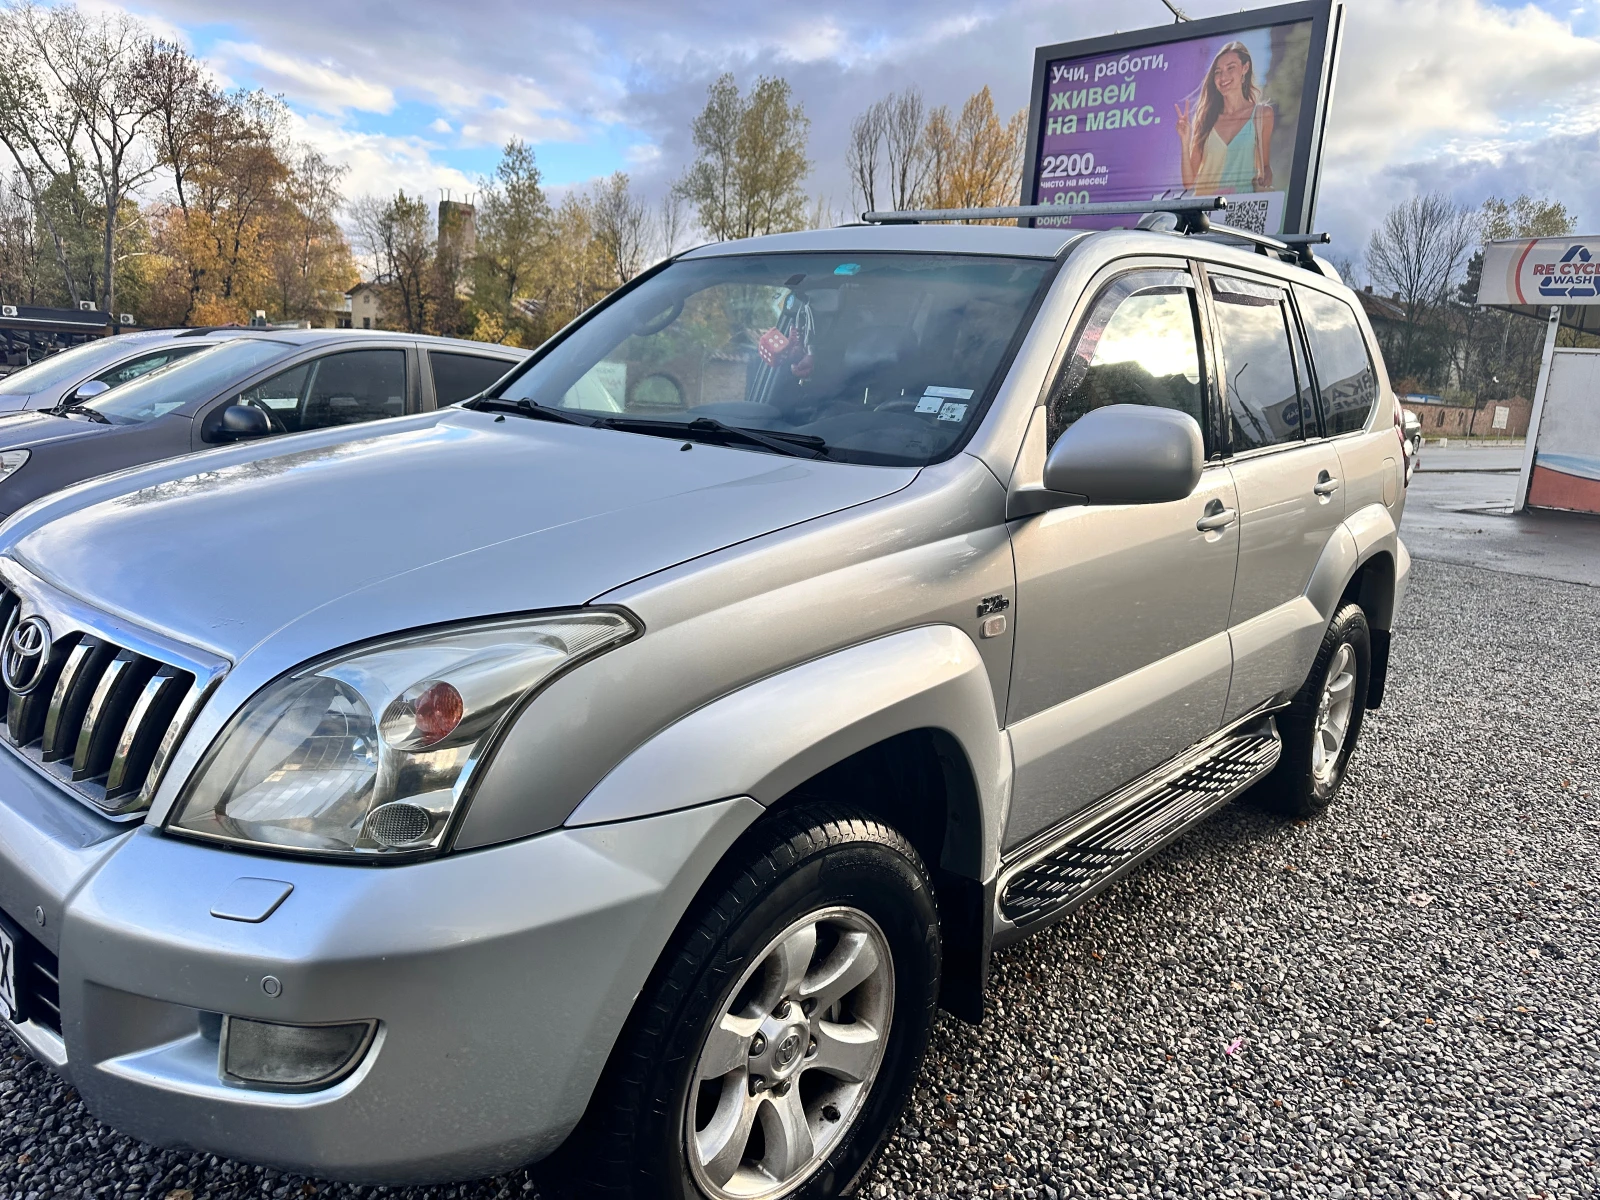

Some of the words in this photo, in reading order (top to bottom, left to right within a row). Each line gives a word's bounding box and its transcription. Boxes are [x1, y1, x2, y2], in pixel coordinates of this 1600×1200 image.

[1052, 65, 1088, 84] Учи,
[1094, 54, 1169, 82] работи,
[1049, 75, 1136, 112] живей
[1047, 114, 1078, 136] на
[1085, 105, 1161, 131] макс.
[1041, 152, 1095, 178] 2200
[1095, 166, 1109, 174] лв.
[1040, 180, 1065, 189] чисто
[1066, 179, 1077, 187] на
[1078, 174, 1109, 187] месец!
[1054, 190, 1090, 206] 800
[1533, 264, 1556, 276] RE
[1554, 276, 1592, 285] WASH
